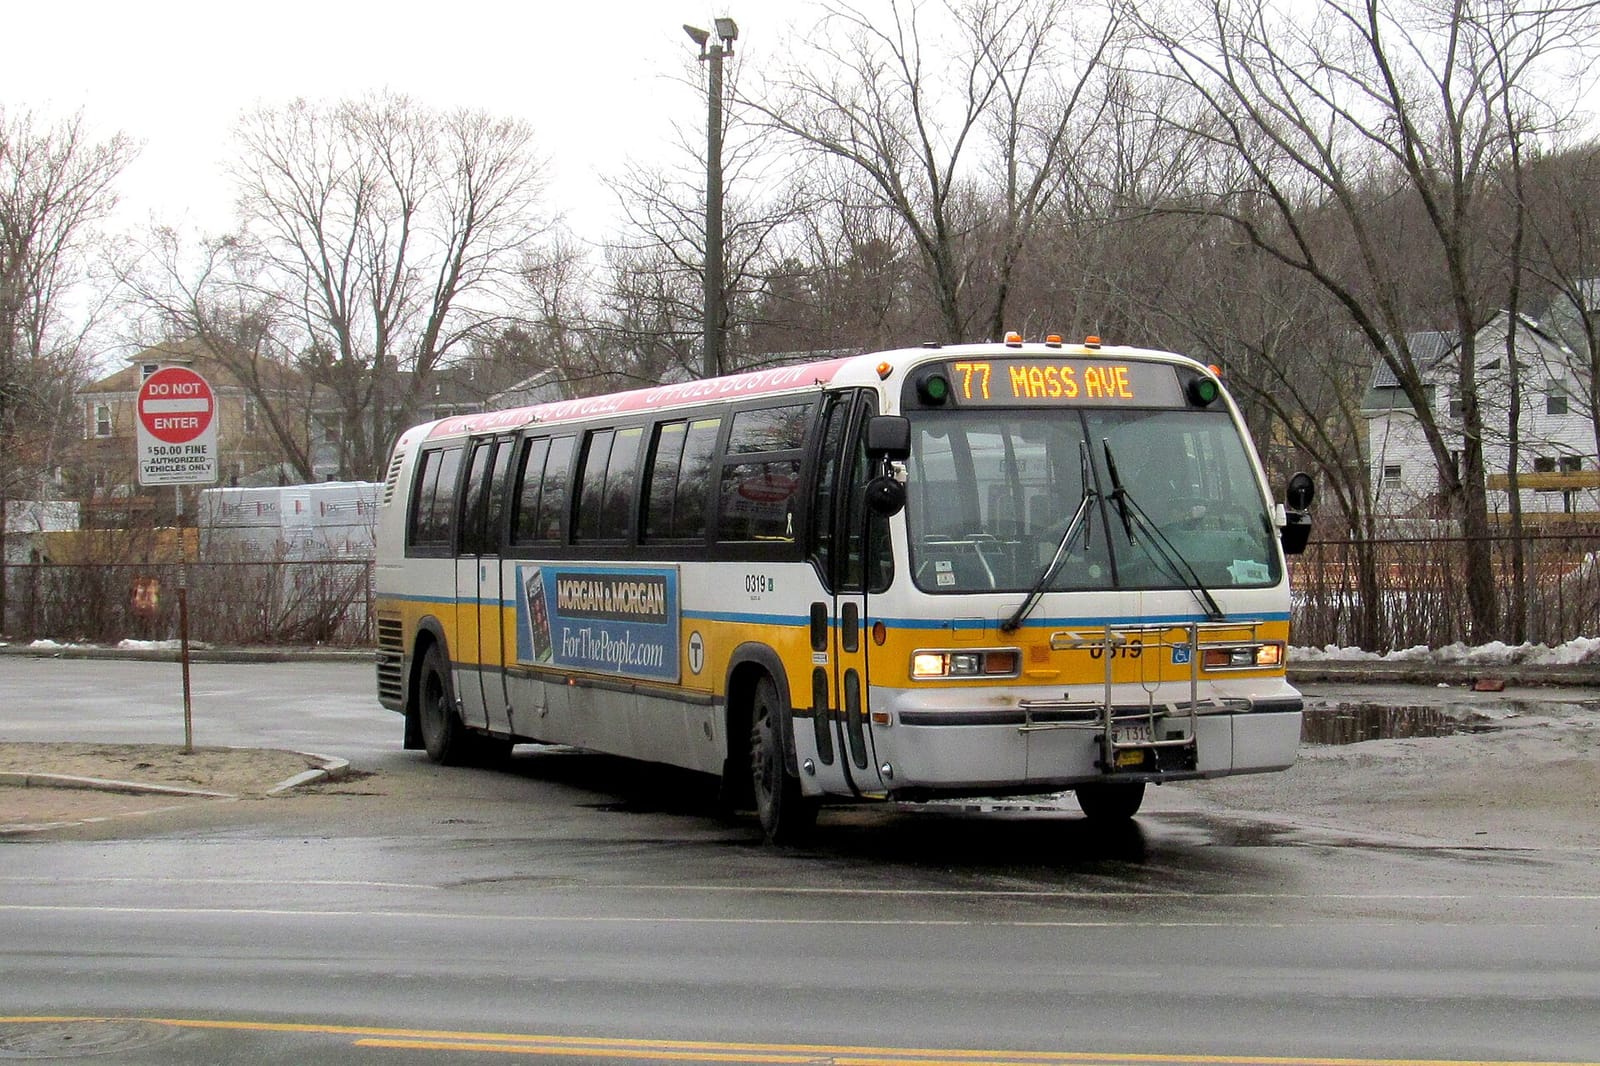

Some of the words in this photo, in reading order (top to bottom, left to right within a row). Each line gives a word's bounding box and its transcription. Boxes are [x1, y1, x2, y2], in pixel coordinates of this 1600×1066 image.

[955, 362, 992, 399] 77
[1008, 365, 1080, 398] MASS
[1084, 366, 1134, 399] AVE
[149, 384, 169, 395] DO
[173, 383, 201, 395] NOT
[154, 417, 199, 429] ENTER
[147, 445, 182, 455] $50.00
[185, 444, 207, 454] FINE
[150, 456, 206, 464] AUTHORIZED
[144, 464, 187, 473] VEHICLES
[188, 463, 212, 471] ONLY
[745, 574, 766, 593] 0319
[557, 580, 605, 612] MORGAN
[605, 587, 613, 612] &
[612, 582, 665, 615] MORGAN
[561, 627, 663, 673] ForThePeople.com
